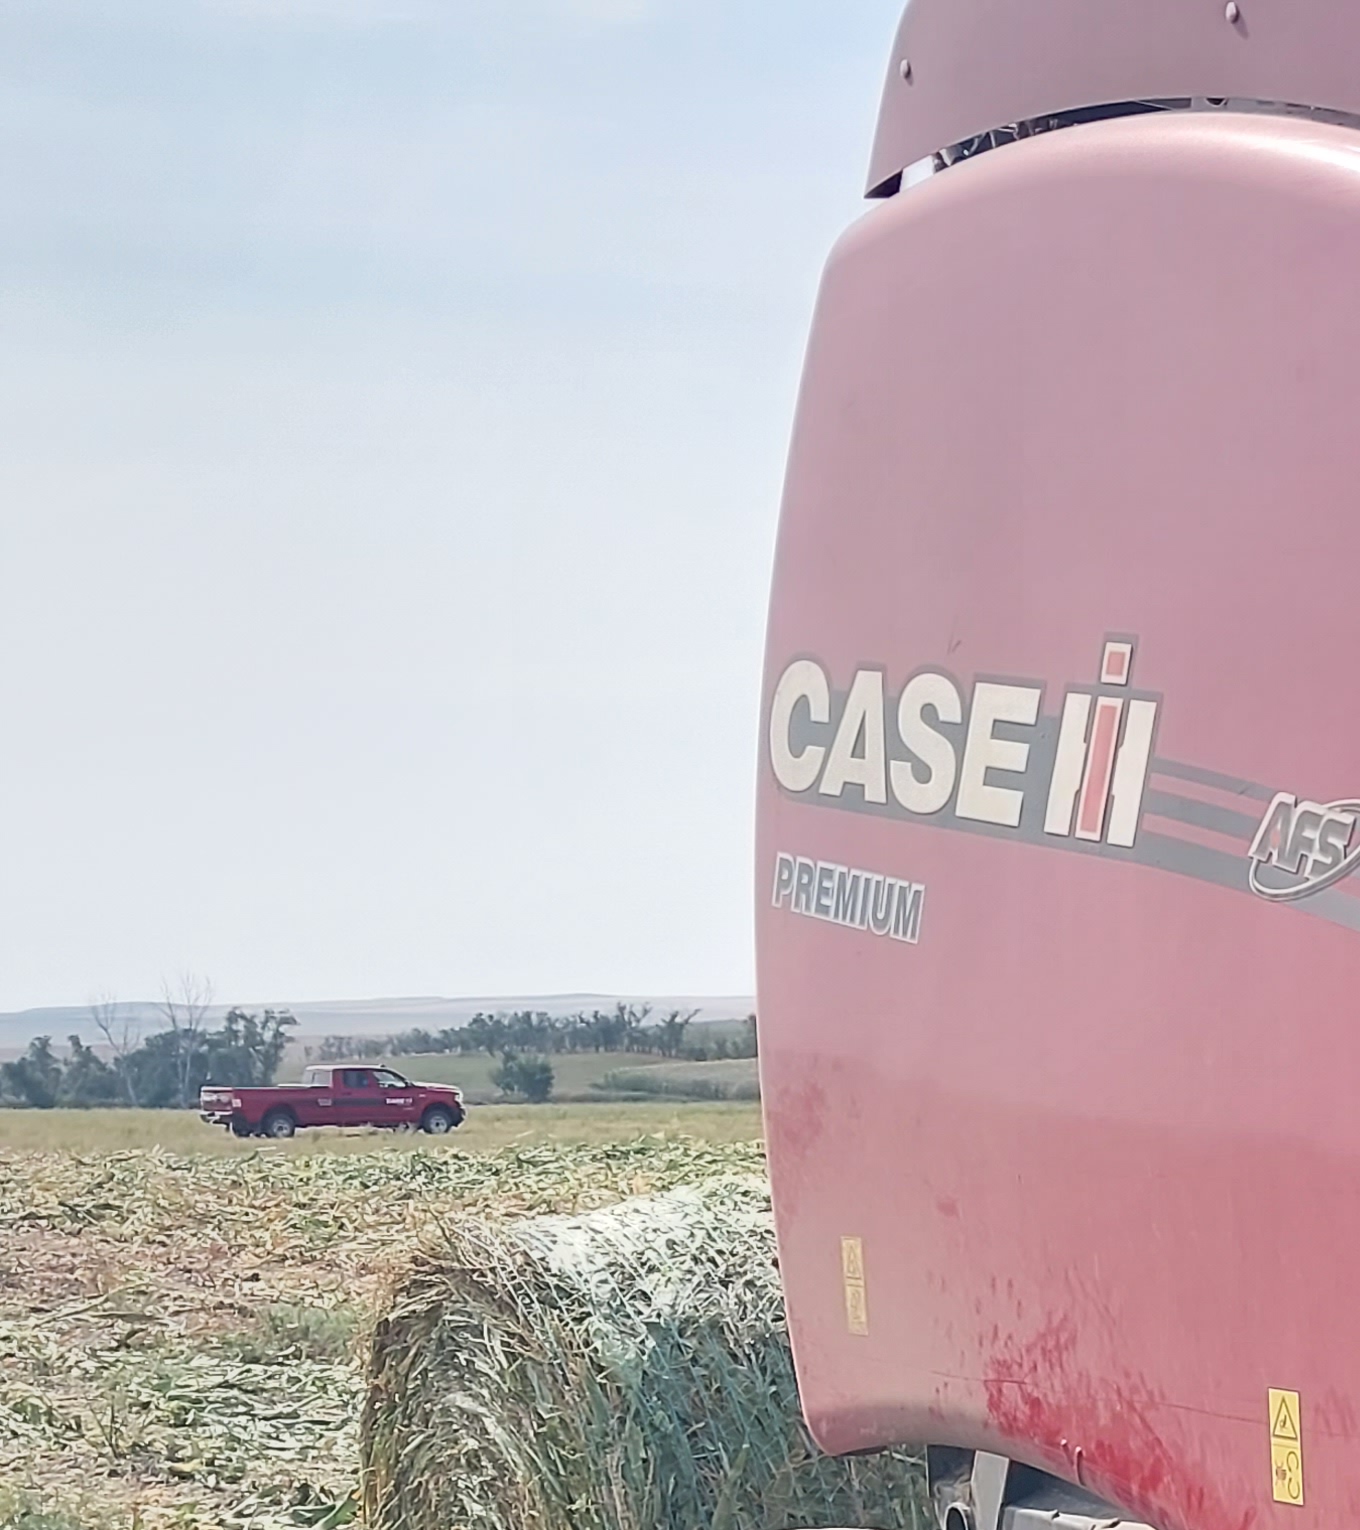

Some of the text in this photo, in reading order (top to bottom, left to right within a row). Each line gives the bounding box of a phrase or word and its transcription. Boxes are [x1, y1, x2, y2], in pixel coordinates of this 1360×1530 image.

[769, 660, 1041, 828] CASE
[1248, 791, 1357, 879] AFS
[772, 851, 925, 944] PREMIUM
